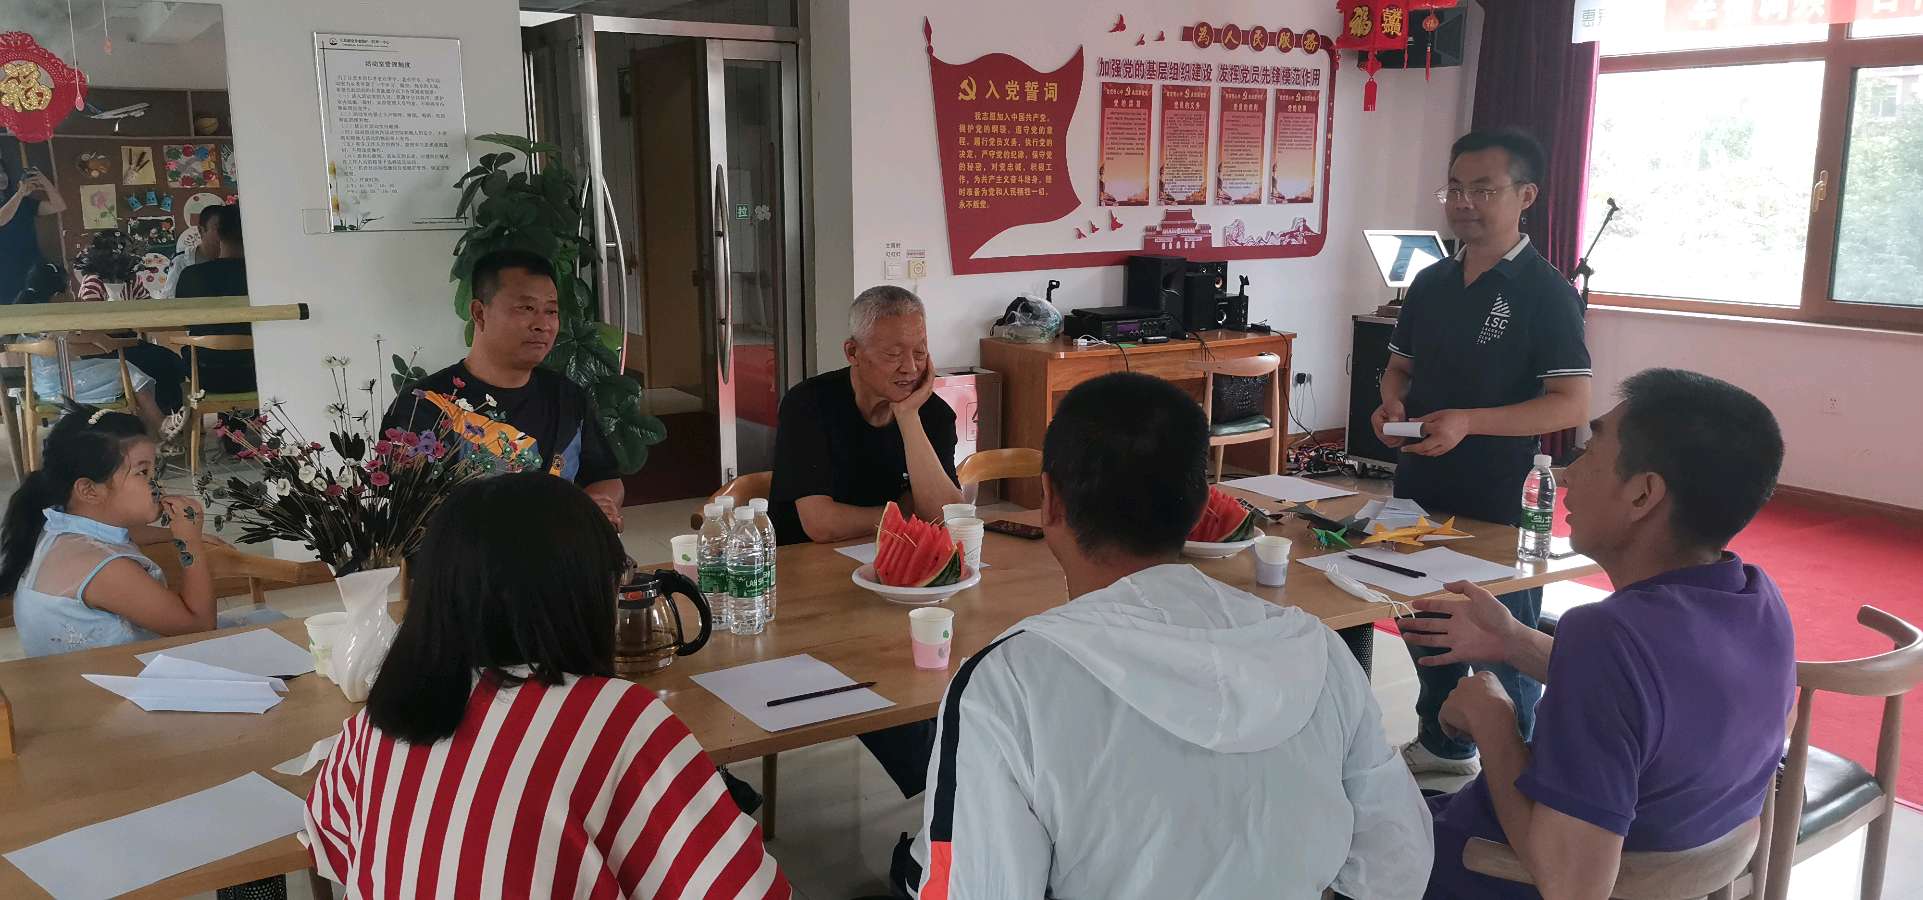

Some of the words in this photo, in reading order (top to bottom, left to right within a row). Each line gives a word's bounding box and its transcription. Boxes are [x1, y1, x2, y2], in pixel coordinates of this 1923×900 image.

[1099, 58, 1213, 82] 加强党的基层组织建设
[1218, 64, 1321, 87] 发挥党员先锋模范作用
[985, 79, 1058, 102] 入党誓词
[737, 206, 748, 217] 拉
[1485, 316, 1508, 329] LSC
